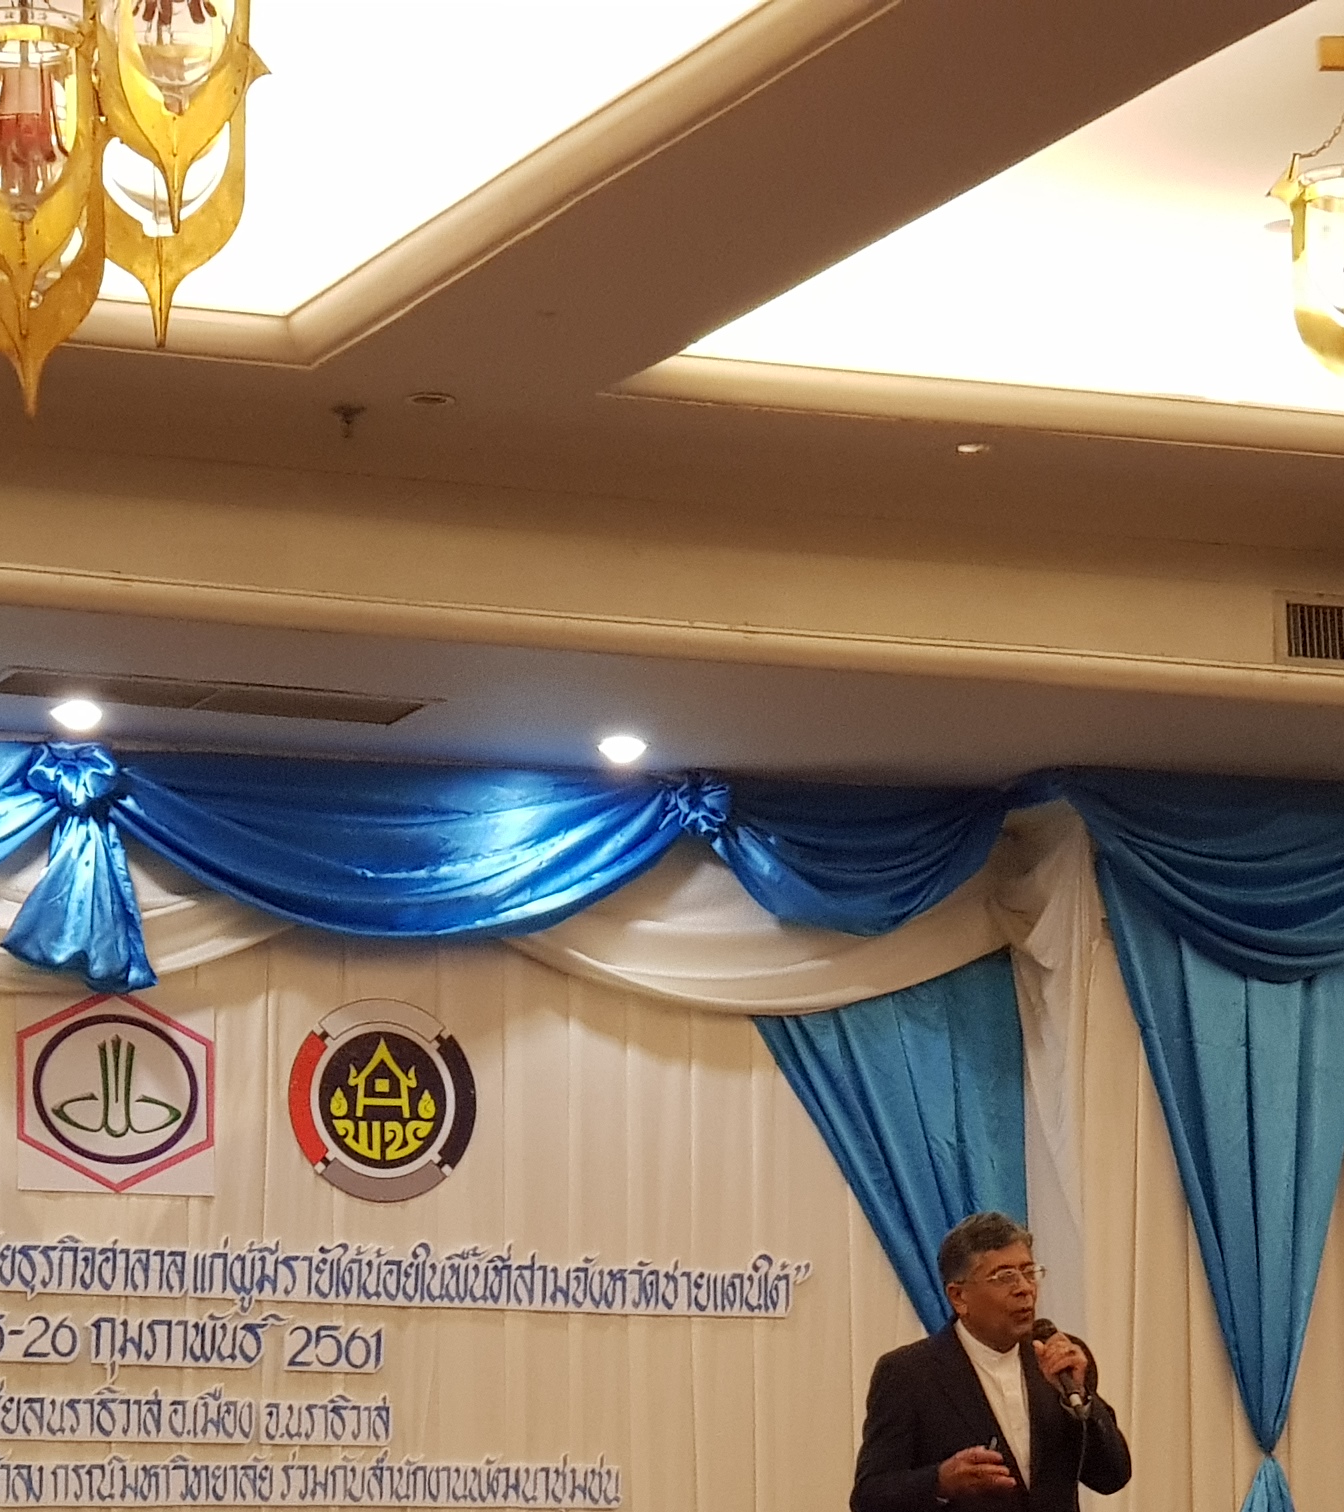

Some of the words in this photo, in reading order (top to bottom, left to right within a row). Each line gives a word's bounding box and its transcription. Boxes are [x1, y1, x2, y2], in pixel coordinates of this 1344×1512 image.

[90, 1311, 287, 1377] กุมภาพันธ์
[287, 1325, 383, 1370] 2561
